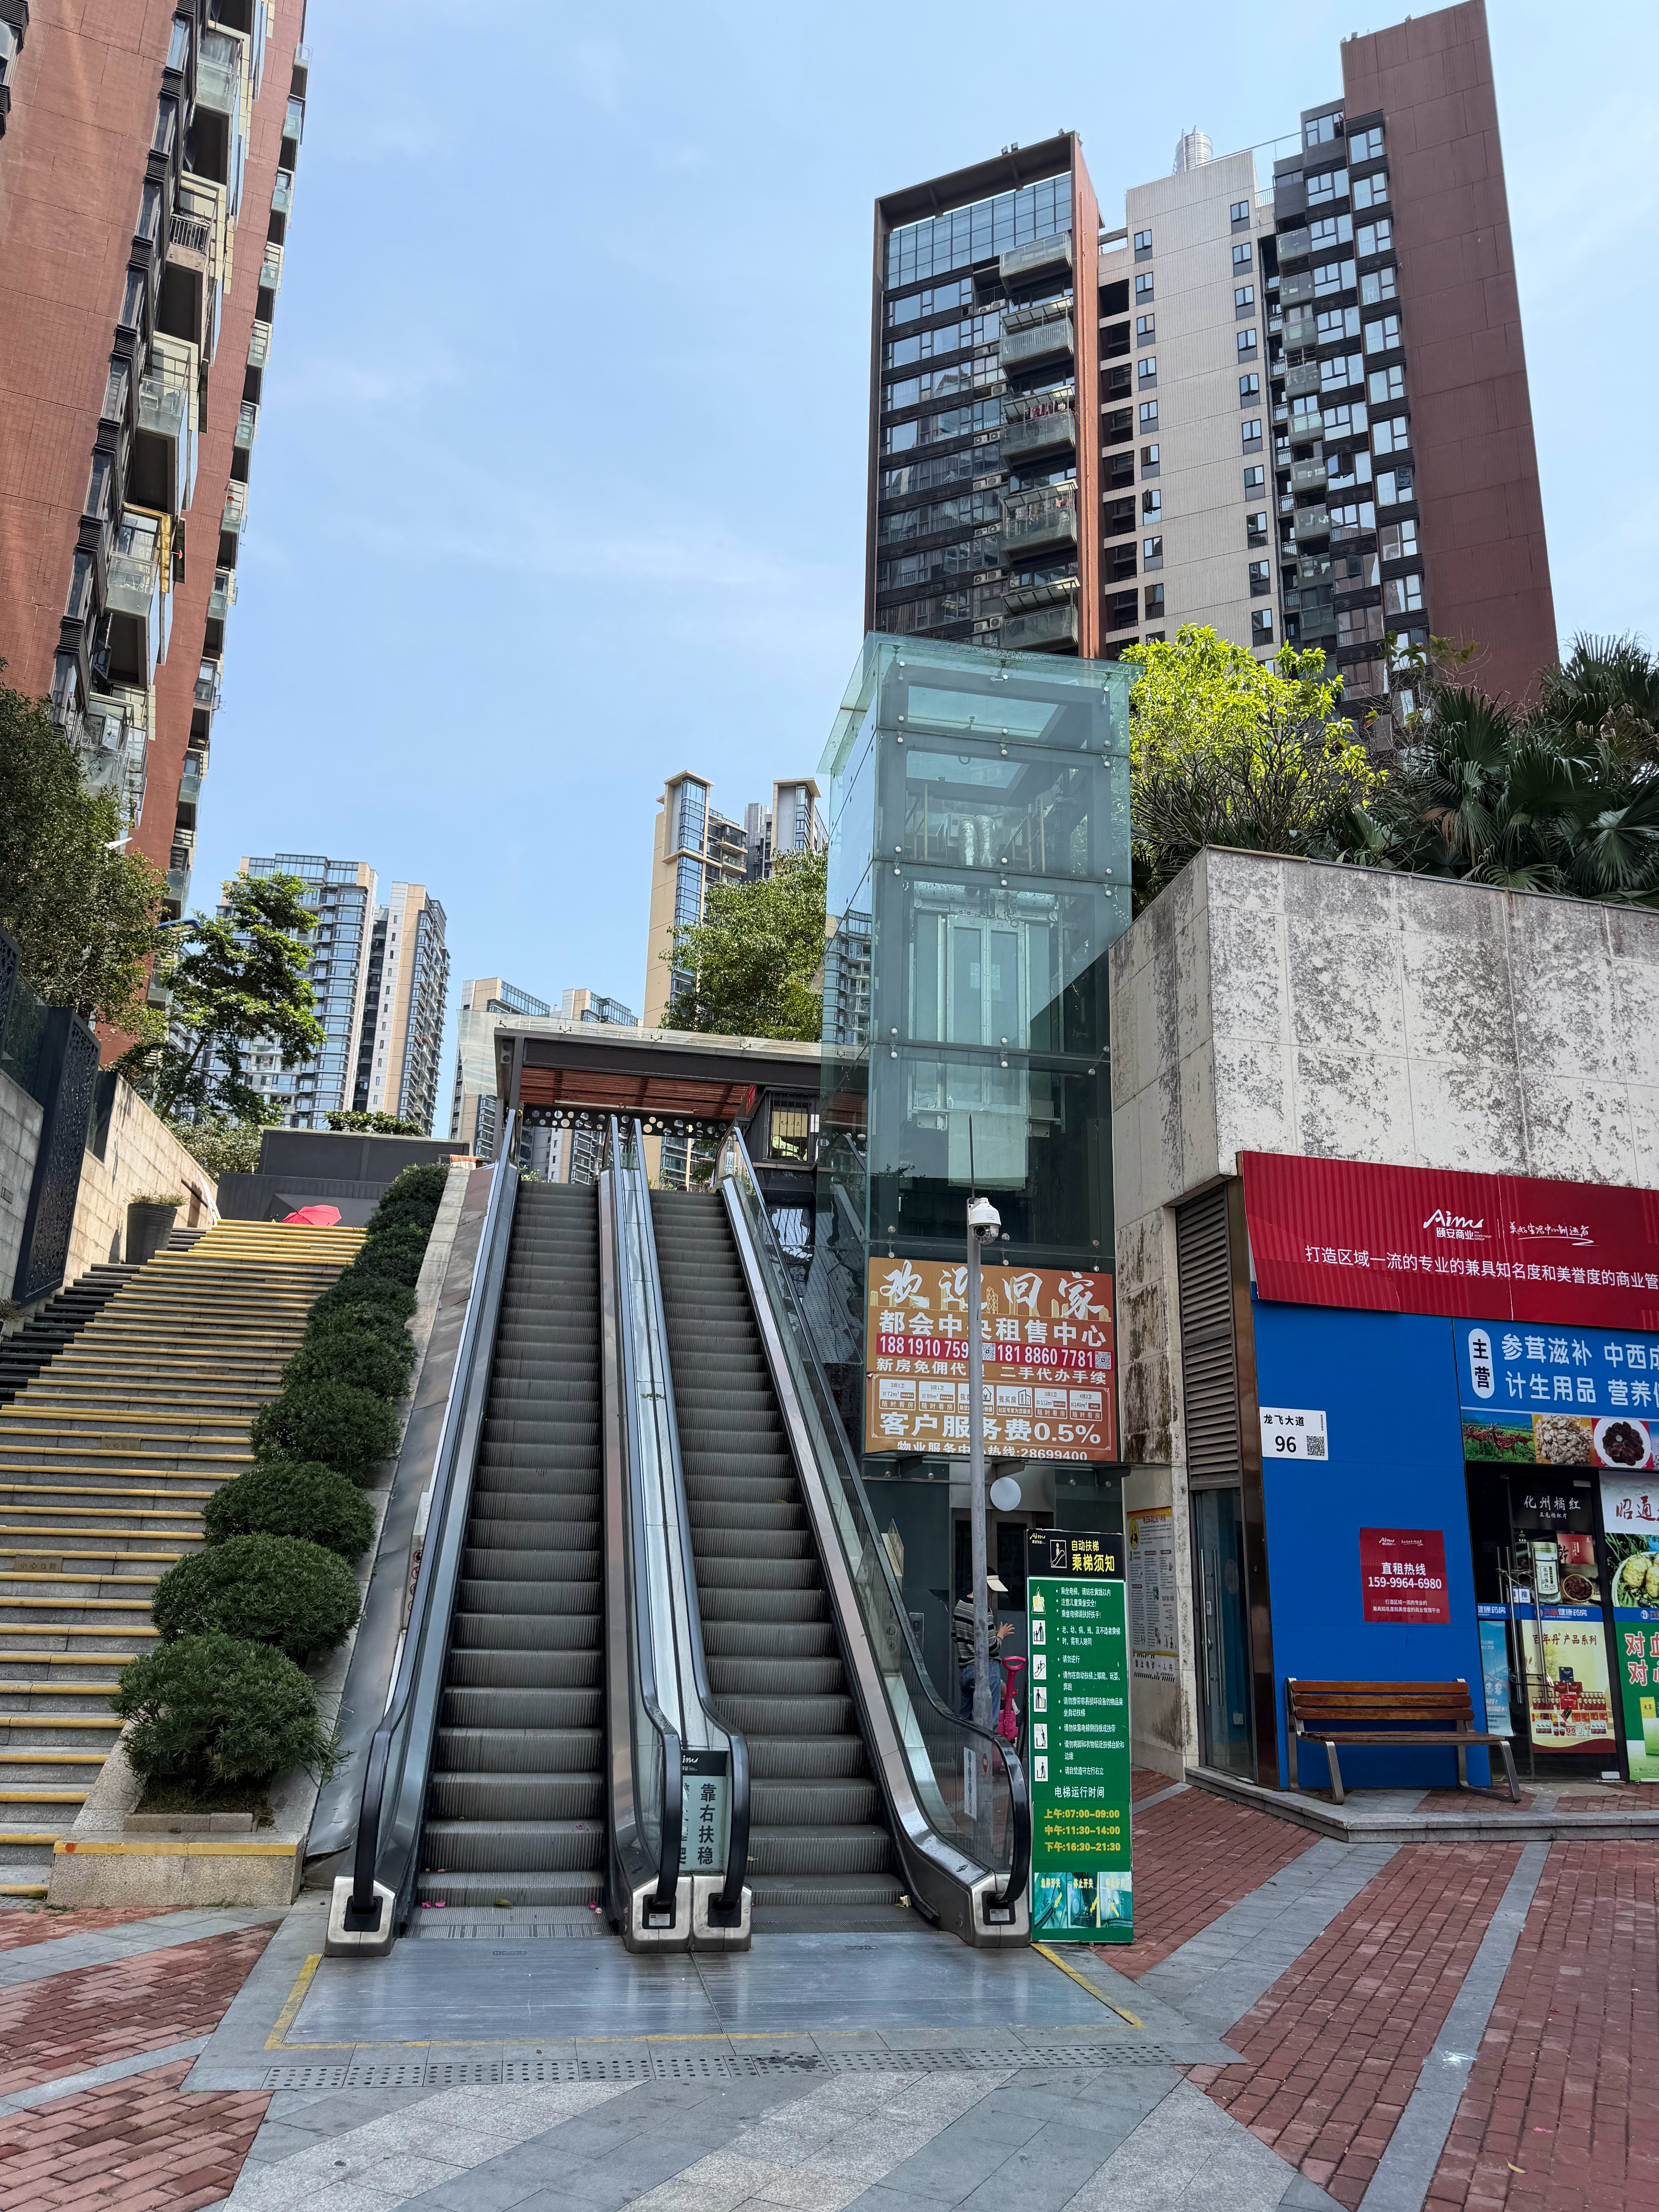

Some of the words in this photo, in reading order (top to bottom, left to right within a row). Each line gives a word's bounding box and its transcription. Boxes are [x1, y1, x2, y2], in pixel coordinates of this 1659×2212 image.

[1436, 1227, 1474, 1240] 颐安商业
[1305, 1245, 1658, 1290] 打造区域一流的专业的兼具知名度和美誉度的商业管
[880, 1336, 904, 1353] 188
[908, 1338, 941, 1357] 1910
[945, 1341, 969, 1358] 759
[998, 1344, 1020, 1362] 181
[1025, 1347, 1057, 1365] 8860
[1061, 1349, 1092, 1368] 7781
[1502, 1333, 1592, 1366] 参茸滋补
[876, 1358, 984, 1377] 新房免佣代
[1000, 1367, 1106, 1385] 二手代办手续
[1473, 1339, 1490, 1389] 主营
[1506, 1371, 1596, 1403] 计生用品
[882, 1400, 913, 1408] 随时看房
[1072, 1411, 1100, 1419] 随时看房
[1264, 1414, 1304, 1426] 龙飞大道
[880, 1412, 1101, 1444] 客户服务费0.5%
[898, 1441, 1087, 1460] 物业服务中热线:28699400
[1275, 1436, 1297, 1453] 96
[1524, 1495, 1581, 1511] 化州橘红
[1616, 1495, 1659, 1521] 昭通
[1072, 1539, 1099, 1551] 自动扶梯
[1072, 1554, 1115, 1572] 乘梯须知
[1381, 1562, 1426, 1576] 直租热线
[1368, 1577, 1442, 1589] 159-9964-6980
[1063, 1655, 1080, 1663] 请勿逆行
[1054, 1786, 1104, 1798] 电梯运行时间
[697, 1783, 716, 1865] 靠右扶稳
